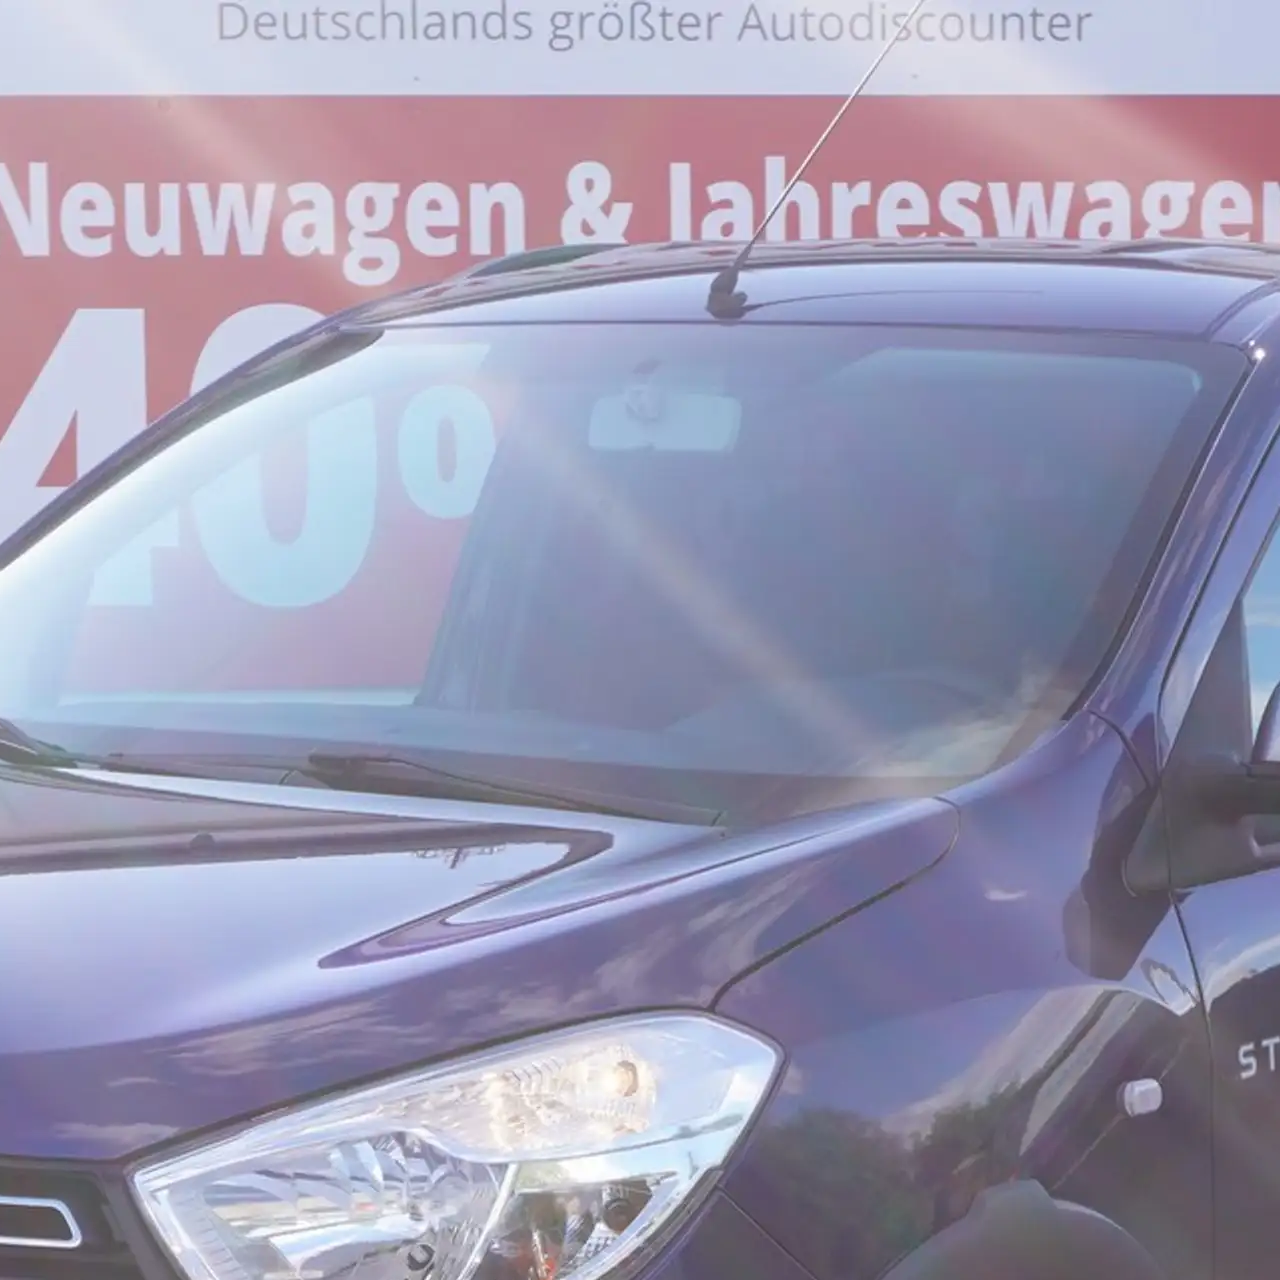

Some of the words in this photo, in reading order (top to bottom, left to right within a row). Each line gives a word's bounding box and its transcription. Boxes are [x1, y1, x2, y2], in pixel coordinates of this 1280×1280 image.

[219, 0, 532, 42] Deutschlands
[548, 2, 722, 52] größter
[737, 0, 1093, 42] Autodiscounter
[560, 161, 633, 245] &
